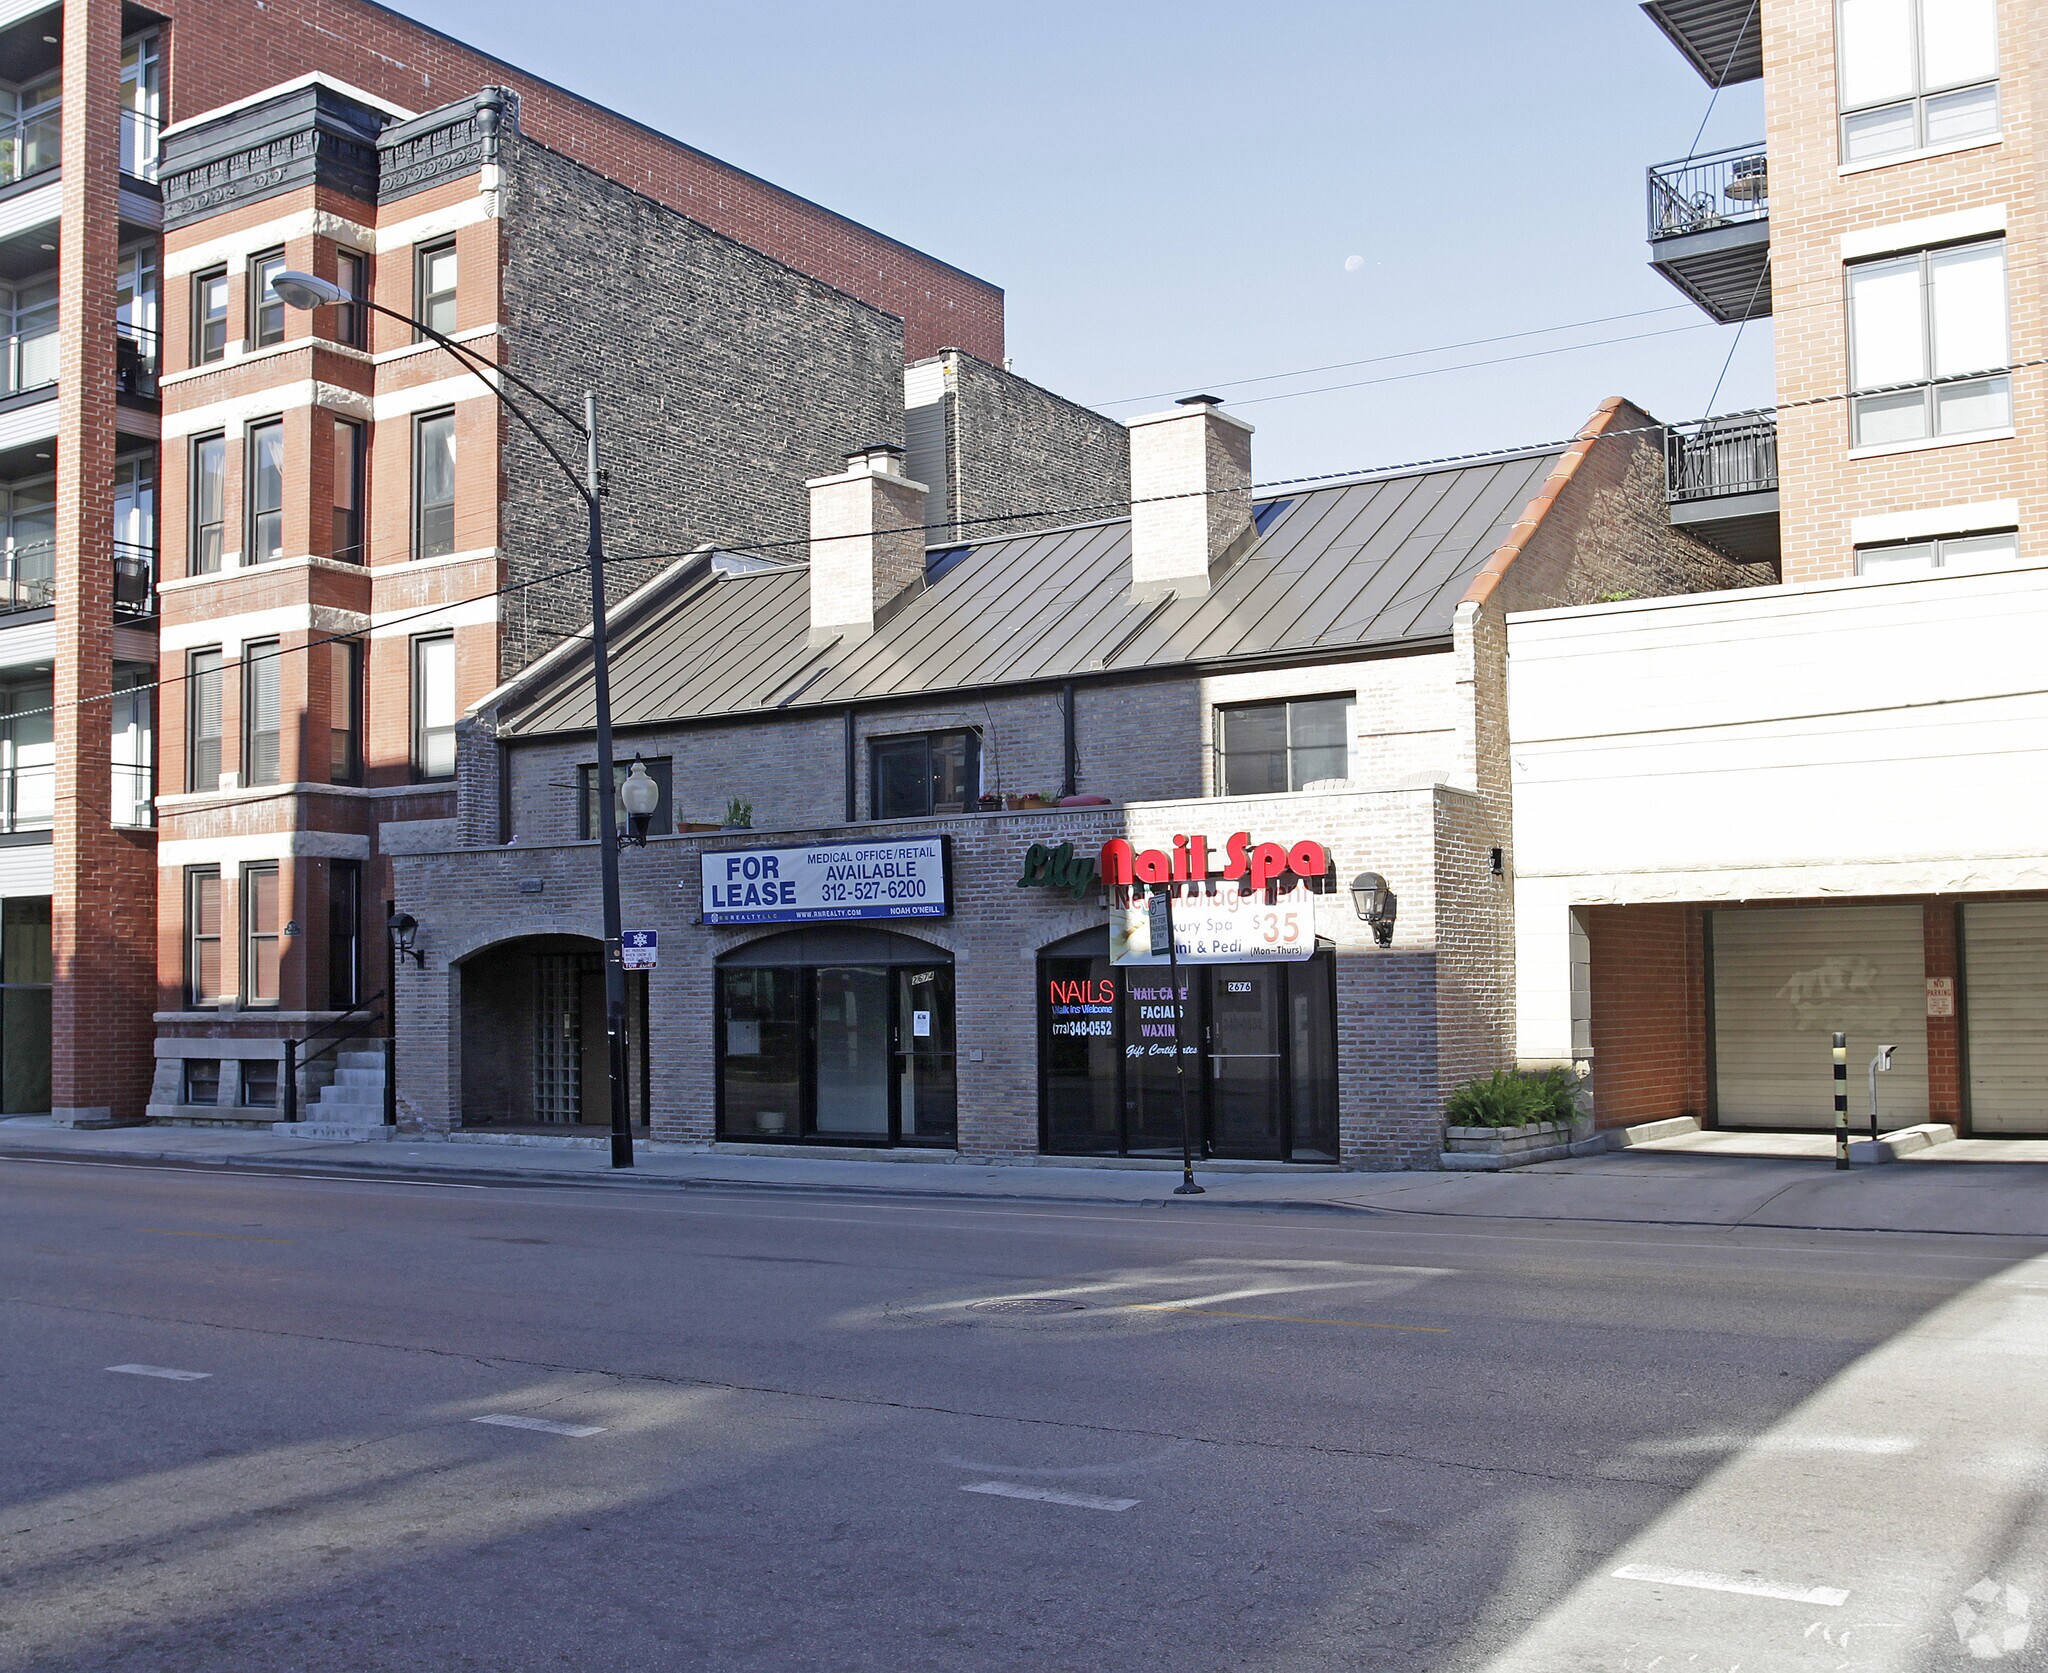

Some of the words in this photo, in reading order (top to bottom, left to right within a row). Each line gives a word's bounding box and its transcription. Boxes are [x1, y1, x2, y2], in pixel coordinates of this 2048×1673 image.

[807, 853, 852, 864] MEDICAL
[855, 847, 936, 861] OFFICE/RETAIL
[1223, 831, 1331, 889] Spa
[726, 855, 779, 881] FOR
[826, 861, 917, 881] AVAILABLE
[711, 881, 797, 908] LEASE
[821, 879, 926, 902] 312-527-6200
[796, 909, 862, 918] WWW.RNREALTY.COM
[890, 907, 911, 915] NOAH
[912, 906, 940, 914] O'NEILL
[1206, 918, 1233, 934] Spa
[1197, 940, 1207, 954] &
[1212, 939, 1242, 954] Pedi
[1050, 979, 1115, 1004] NAILS
[1229, 982, 1251, 991] 2676
[1933, 980, 1944, 988] NO
[1133, 987, 1157, 1000] NAIL
[1159, 987, 1188, 1000] CAE
[1081, 1004, 1113, 1014] Welcome
[1141, 1024, 1183, 1037] WAXIN
[1126, 1044, 1145, 1058] Gift
